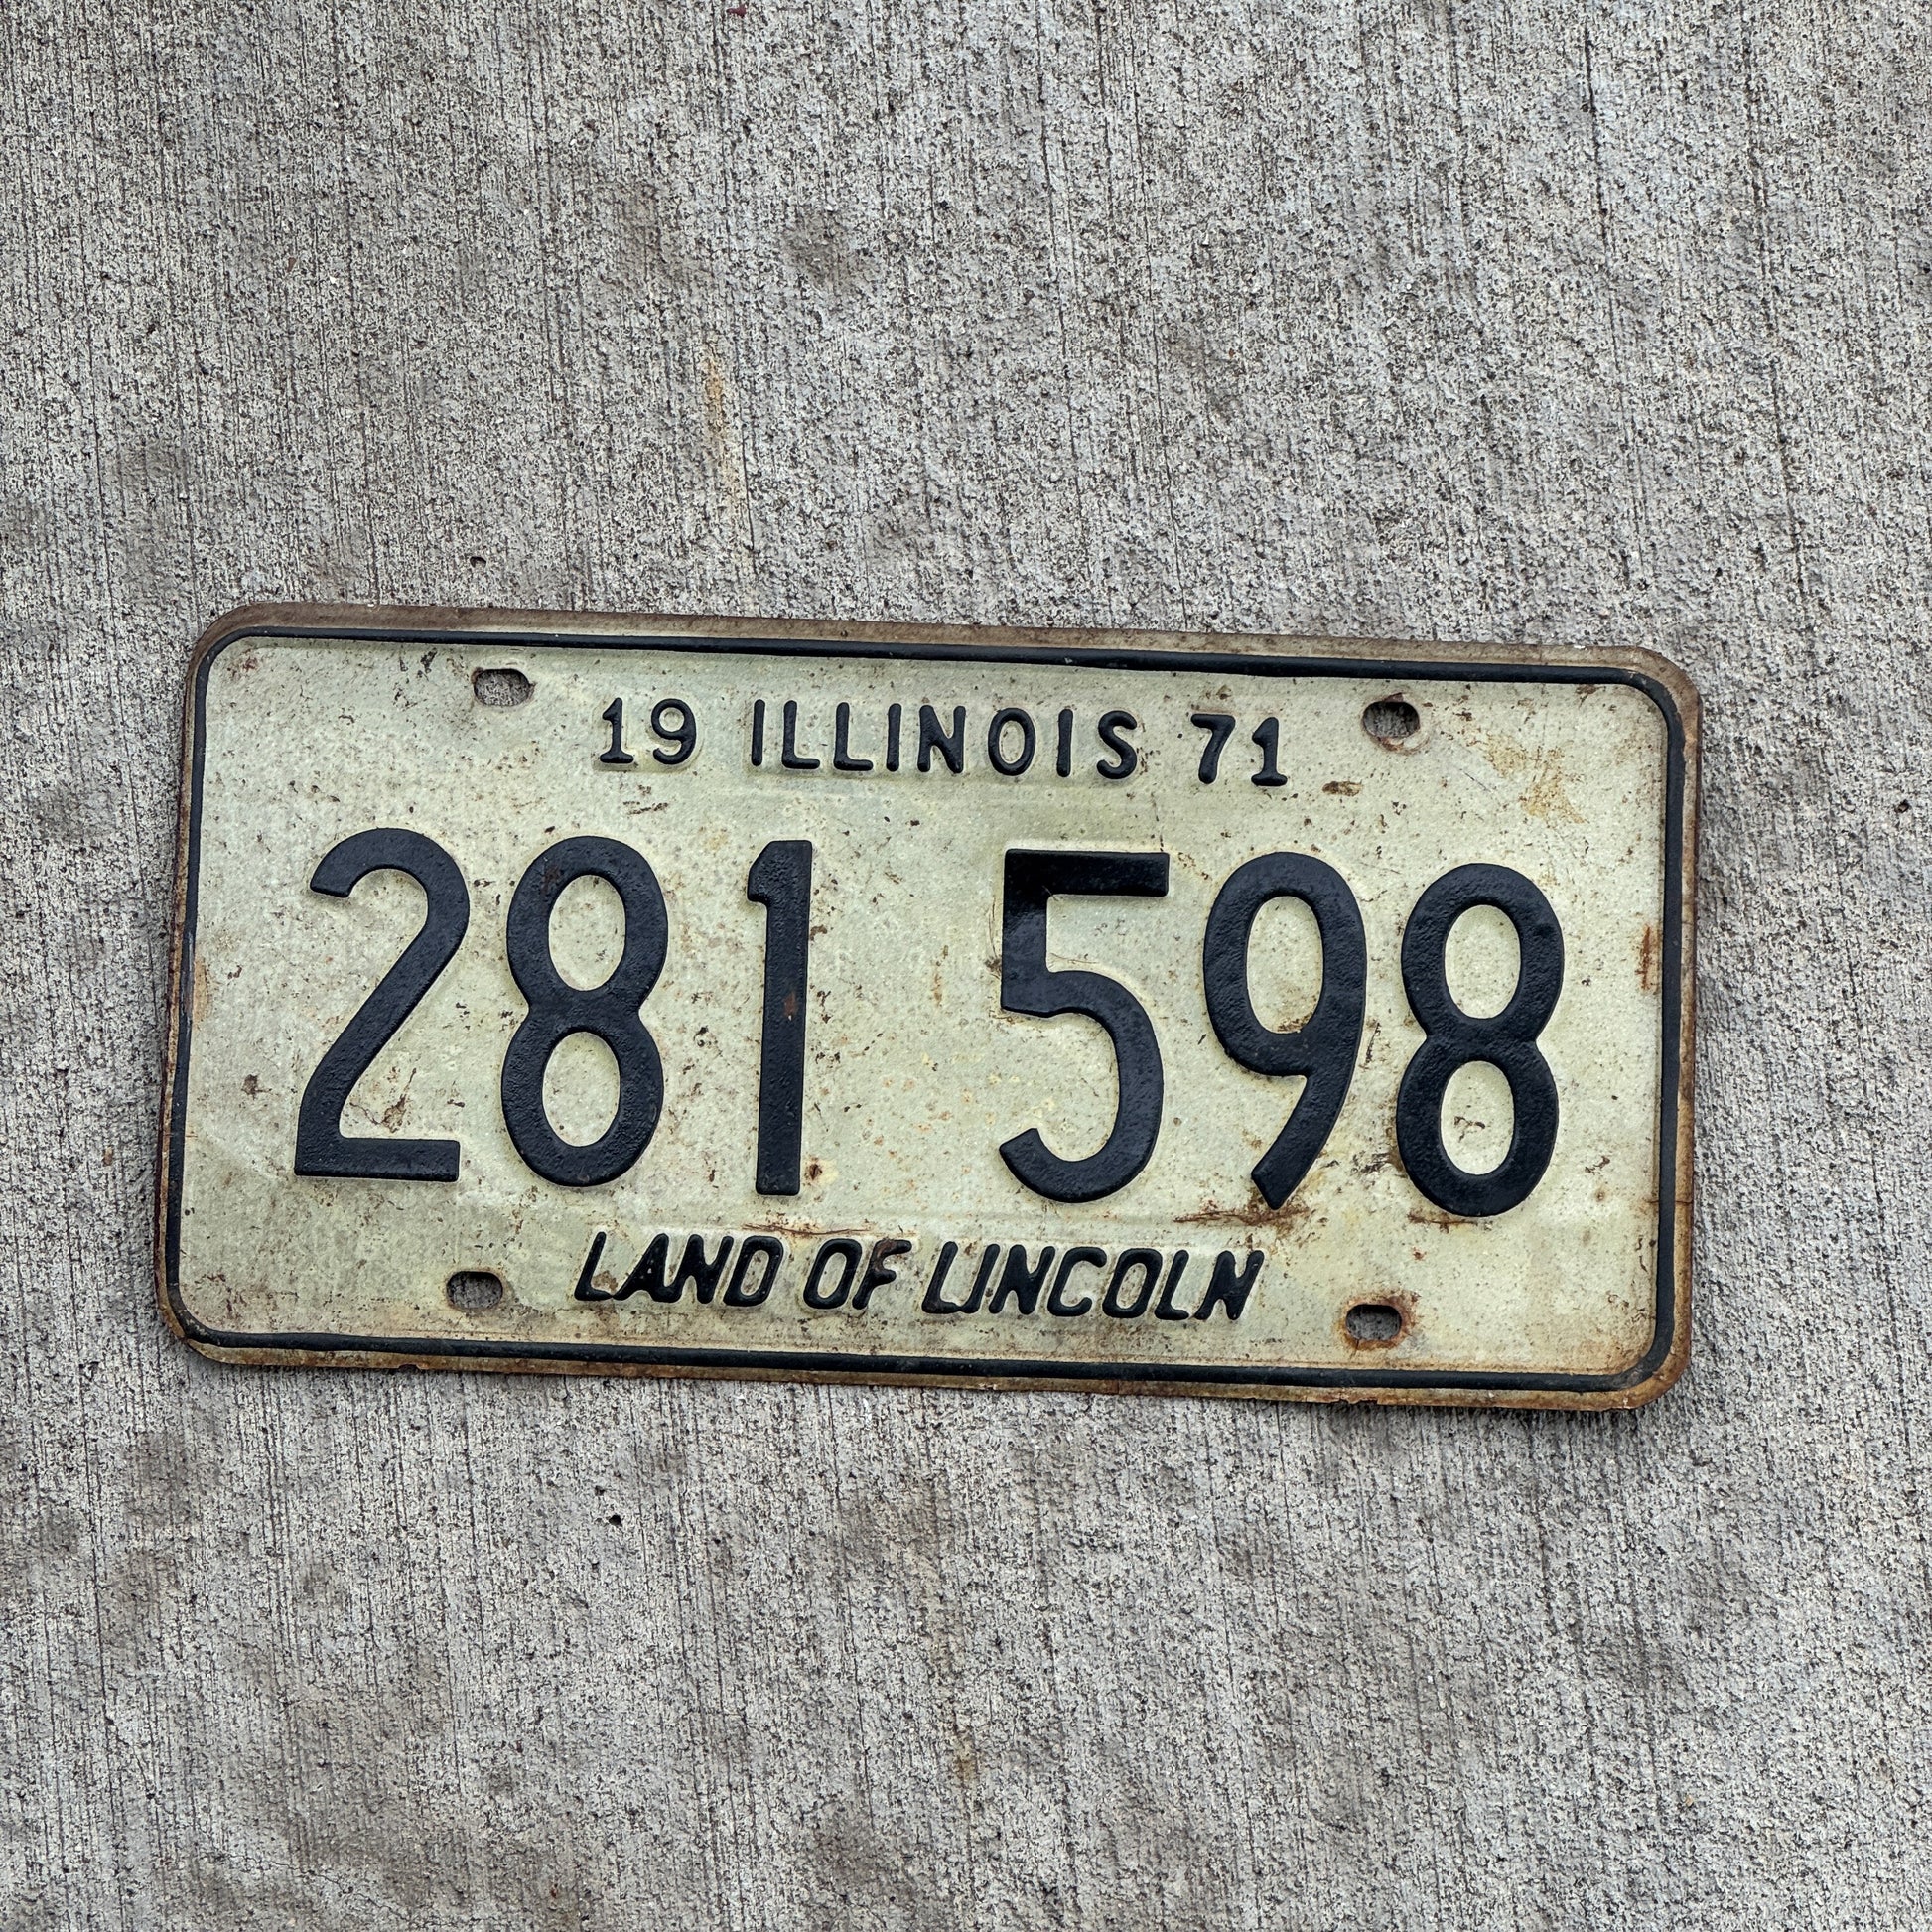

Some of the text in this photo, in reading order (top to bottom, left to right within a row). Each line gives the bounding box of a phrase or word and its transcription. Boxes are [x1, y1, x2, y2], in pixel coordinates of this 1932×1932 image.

[599, 697, 1288, 787] 19 ILLINOIS 71
[294, 827, 1565, 1218] 281 598
[574, 1231, 1265, 1322] LAND OF LINCOLN
